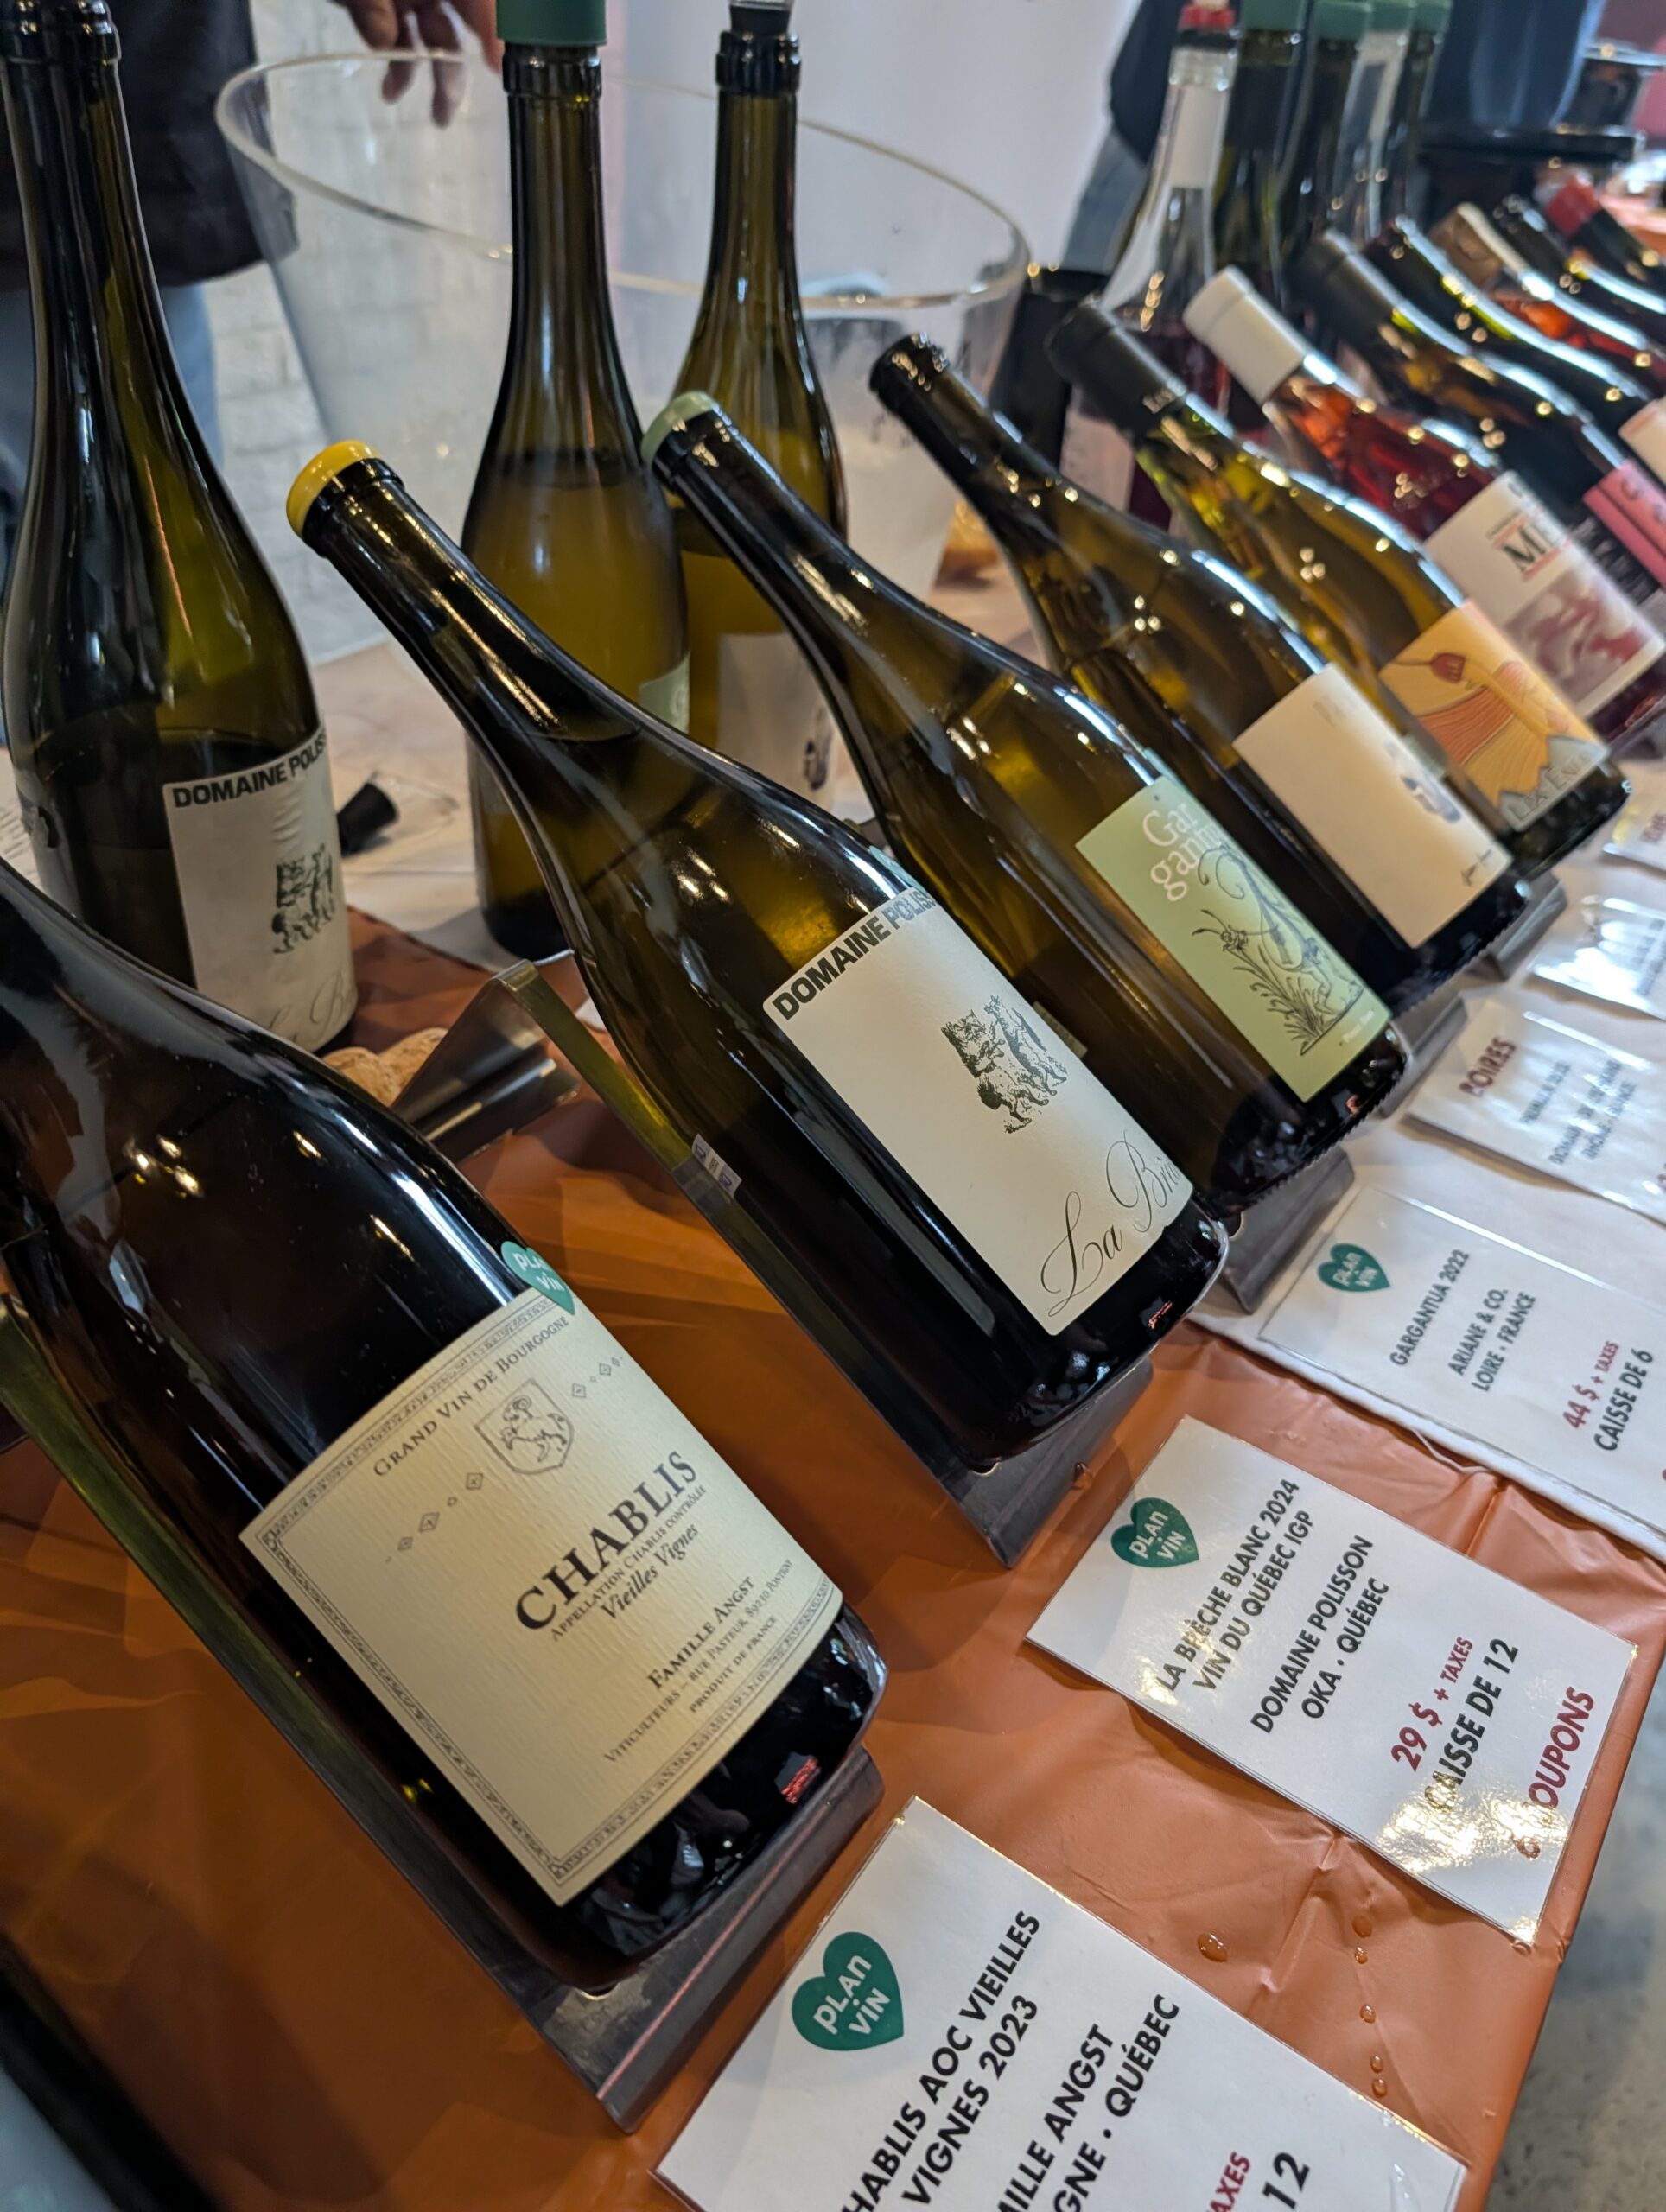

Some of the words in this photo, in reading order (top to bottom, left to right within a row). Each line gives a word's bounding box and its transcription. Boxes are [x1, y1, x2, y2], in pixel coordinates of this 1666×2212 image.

[172, 762, 288, 808] DOMAINE
[1142, 803, 1199, 847] Gar
[772, 916, 892, 1020] DOMAINE
[1041, 1191, 1122, 1317] La
[1389, 1283, 1450, 1366] GARGANTUA
[1439, 1249, 1469, 1286] 2022
[1447, 1322, 1487, 1376] ARIANE
[1471, 1350, 1504, 1393] LOIRE
[1497, 1291, 1536, 1344] FRANCE
[1594, 1340, 1619, 1372] TAXES
[1631, 1347, 1653, 1363] 6
[373, 1420, 438, 1477] GRAND
[436, 1390, 474, 1419] VIN
[474, 1370, 498, 1393] DE
[494, 1316, 569, 1374] BOURGOGNE
[1562, 1400, 1591, 1428] 44
[1572, 1384, 1600, 1402] $
[1593, 1387, 1637, 1451] CAISSE
[1618, 1362, 1648, 1389] DE
[516, 1451, 696, 1630] CHABLIS
[550, 1567, 626, 1642] APPELLATION
[624, 1527, 666, 1568] CHABLIS
[600, 1565, 658, 1619] Vieilles
[653, 1523, 699, 1567] Vignes
[1156, 1663, 1186, 1691] LA
[1173, 1586, 1232, 1662] BRÈCHE
[1220, 1525, 1270, 1588] BLANC
[1260, 1479, 1300, 1527] 2024
[647, 1622, 715, 1690] FAMILLE
[713, 1576, 755, 1623] ANGST
[1192, 1651, 1231, 1691] VIN
[1219, 1617, 1250, 1651] DU
[1241, 1543, 1296, 1617] QUÉBEC
[1284, 1510, 1314, 1545] IGP
[1250, 1630, 1320, 1733] DOMAINE
[1307, 1535, 1373, 1631] POLISSON
[1301, 1669, 1341, 1719] OKA
[1336, 1577, 1389, 1654] QUÉBEC
[690, 1667, 734, 1713] PRODUIT
[734, 1651, 746, 1666] DE
[747, 1616, 777, 1651] FRANCE
[1440, 1636, 1472, 1683] TAXES
[1465, 1675, 1502, 1717] DE
[1483, 1638, 1518, 1674] 12
[604, 1691, 681, 1763] VITICULTEURS
[689, 1659, 709, 1682] RUE
[1391, 1726, 1427, 1772] 29
[1408, 1702, 1442, 1726] $
[1522, 1686, 1594, 1825] OUPONS
[1425, 1713, 1485, 1812] CAISSE
[919, 2025, 973, 2105] AOC
[959, 1910, 1040, 2021] VIEILLES
[1105, 1994, 1179, 2117] QUÉBEC
[901, 2078, 989, 2205] VIGNES
[979, 1995, 1037, 2080] 2023
[1043, 2024, 1113, 2143] ANGST
[1262, 2152, 1310, 2210] 12
